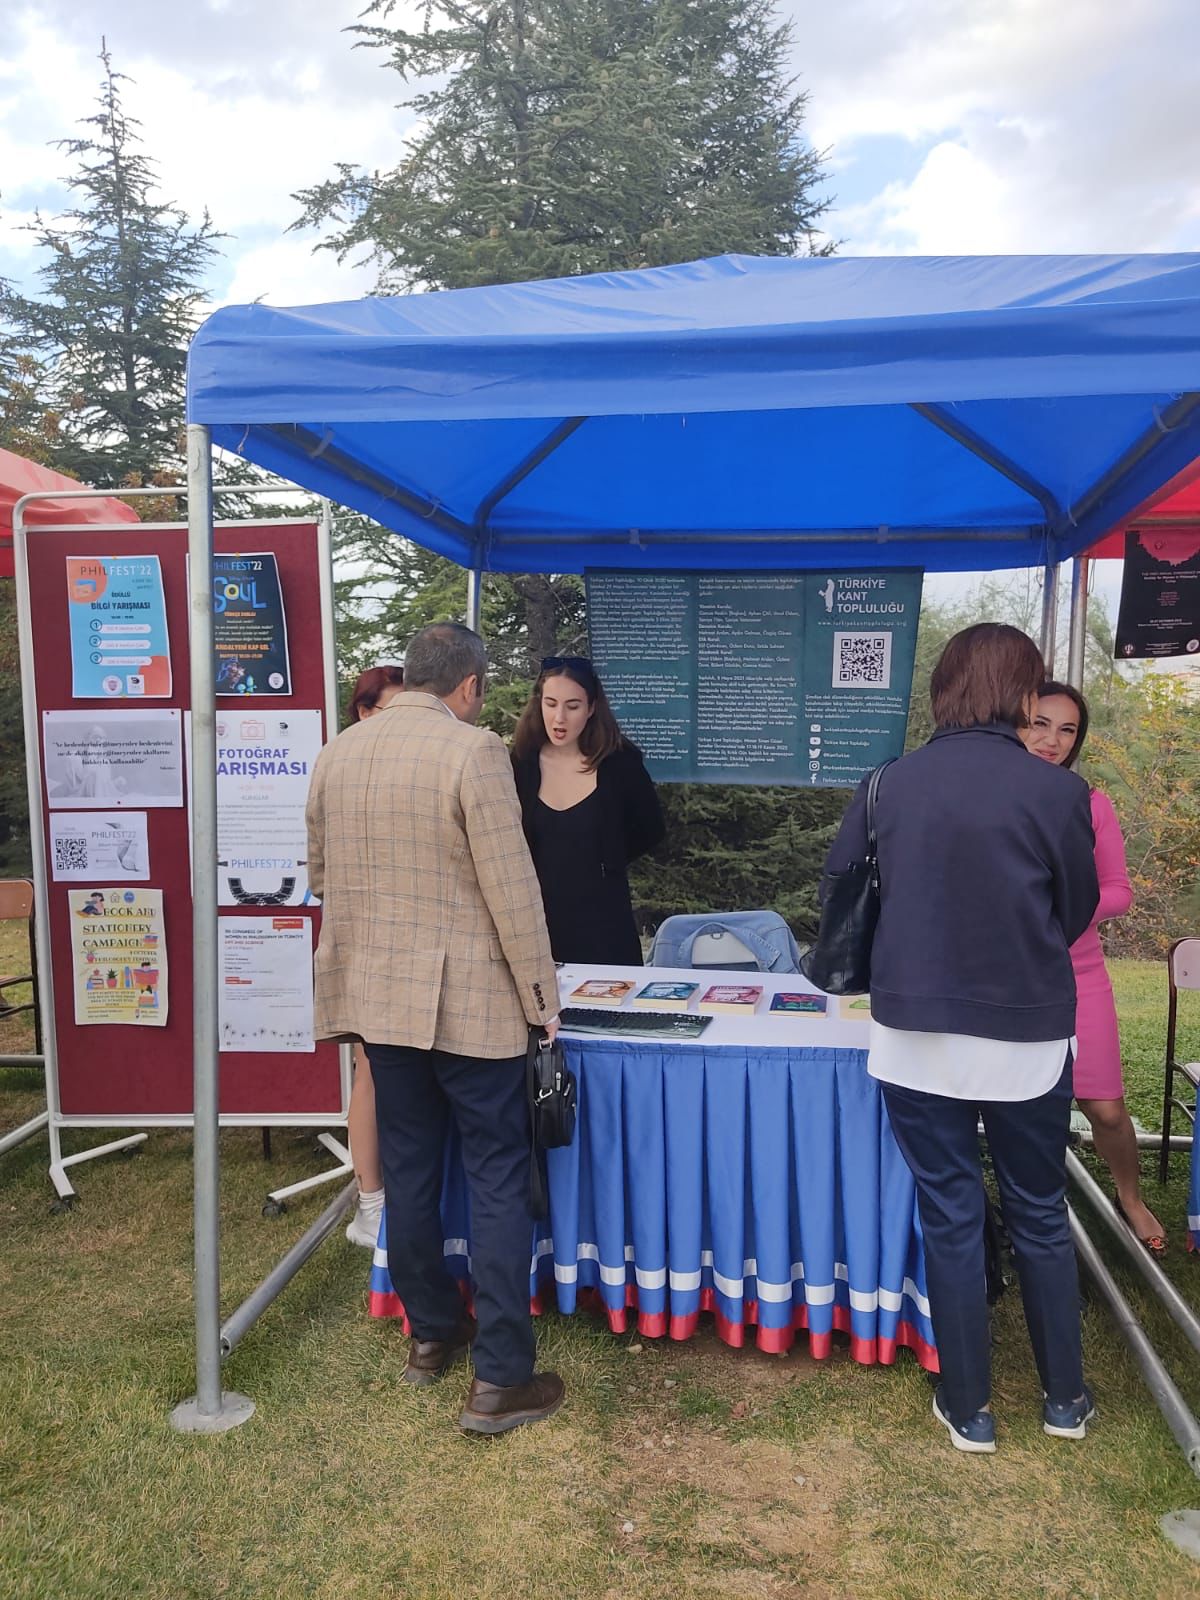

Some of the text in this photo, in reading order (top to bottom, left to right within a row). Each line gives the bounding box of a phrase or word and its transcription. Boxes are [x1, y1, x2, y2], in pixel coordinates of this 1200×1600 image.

[80, 565, 152, 576] PHILFEST'22
[214, 560, 262, 570] HILFEST'22
[838, 577, 886, 589] TÜRKİYE
[214, 576, 267, 613] SOUL
[837, 592, 868, 601] KANT
[91, 602, 150, 612] BİLGİ YARIŞMASI
[837, 602, 904, 613] TOPLULUĞU
[219, 746, 290, 759] FOTOĞRAF
[217, 762, 307, 779] ARIŞMASI
[231, 859, 293, 868] PHILFEST'22
